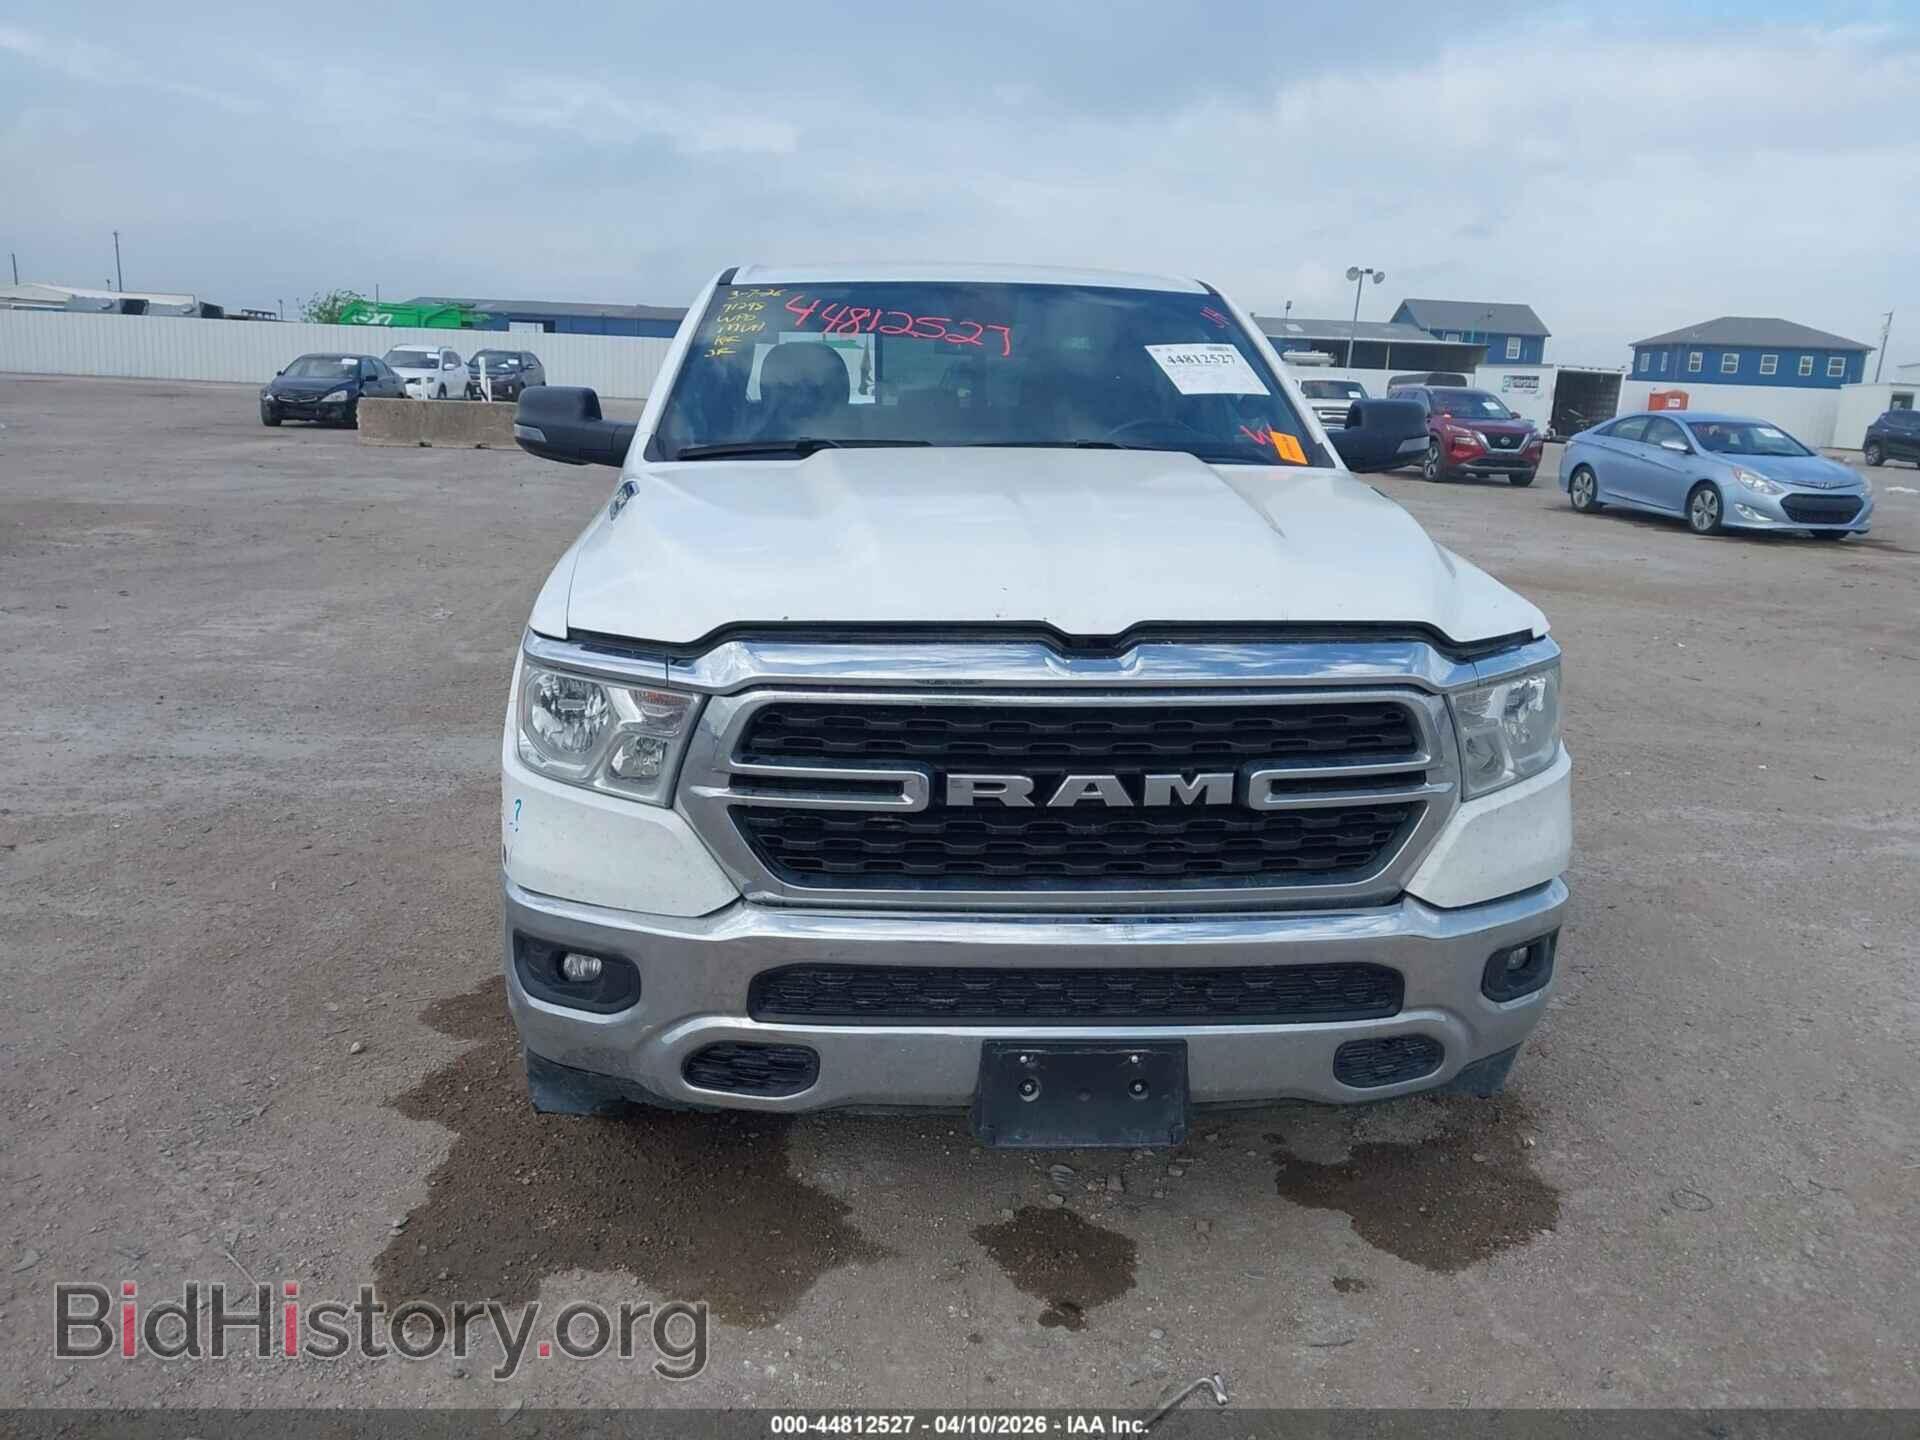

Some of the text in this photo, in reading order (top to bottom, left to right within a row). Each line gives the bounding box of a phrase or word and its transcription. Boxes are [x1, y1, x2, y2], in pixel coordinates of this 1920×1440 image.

[784, 295, 1011, 357] 44812527
[1167, 354, 1235, 365] 44812527
[946, 773, 1234, 807] RAM
